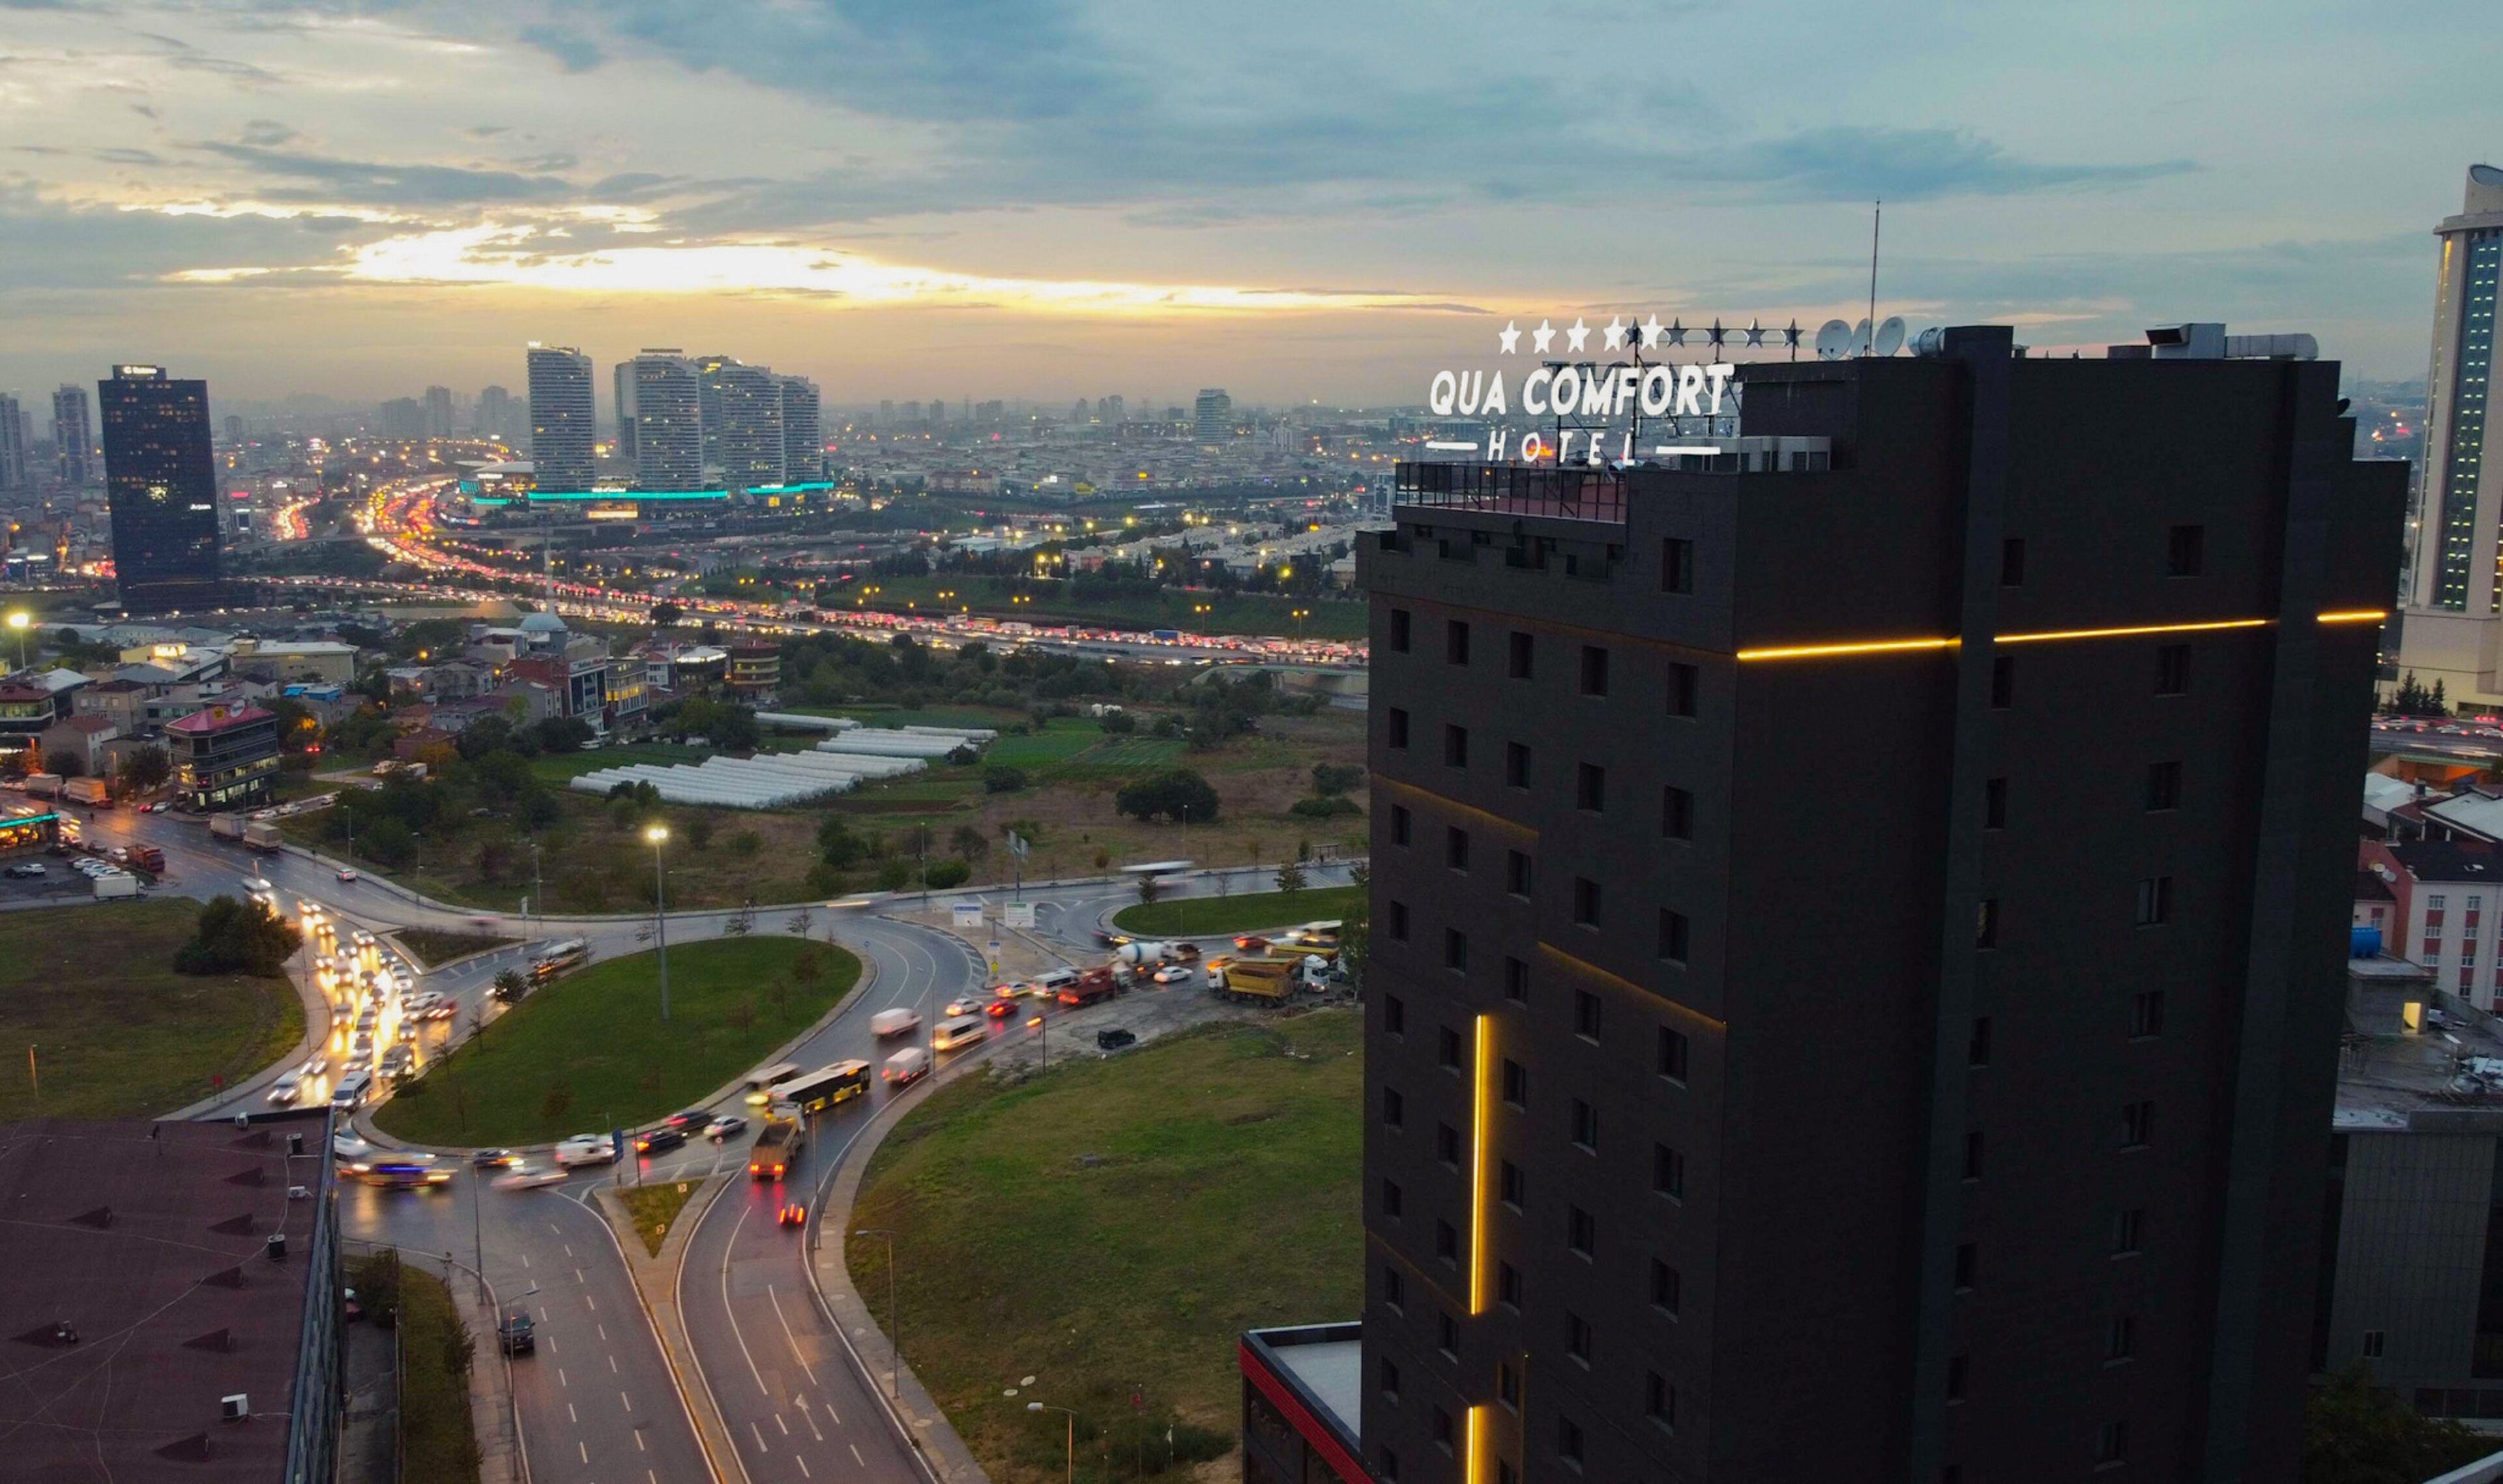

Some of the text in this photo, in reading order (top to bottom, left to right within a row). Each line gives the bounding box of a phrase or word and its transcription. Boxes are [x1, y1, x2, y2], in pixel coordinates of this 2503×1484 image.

[1429, 363, 1735, 416] QUA COMFORT
[1487, 430, 1635, 466] HOTEL
